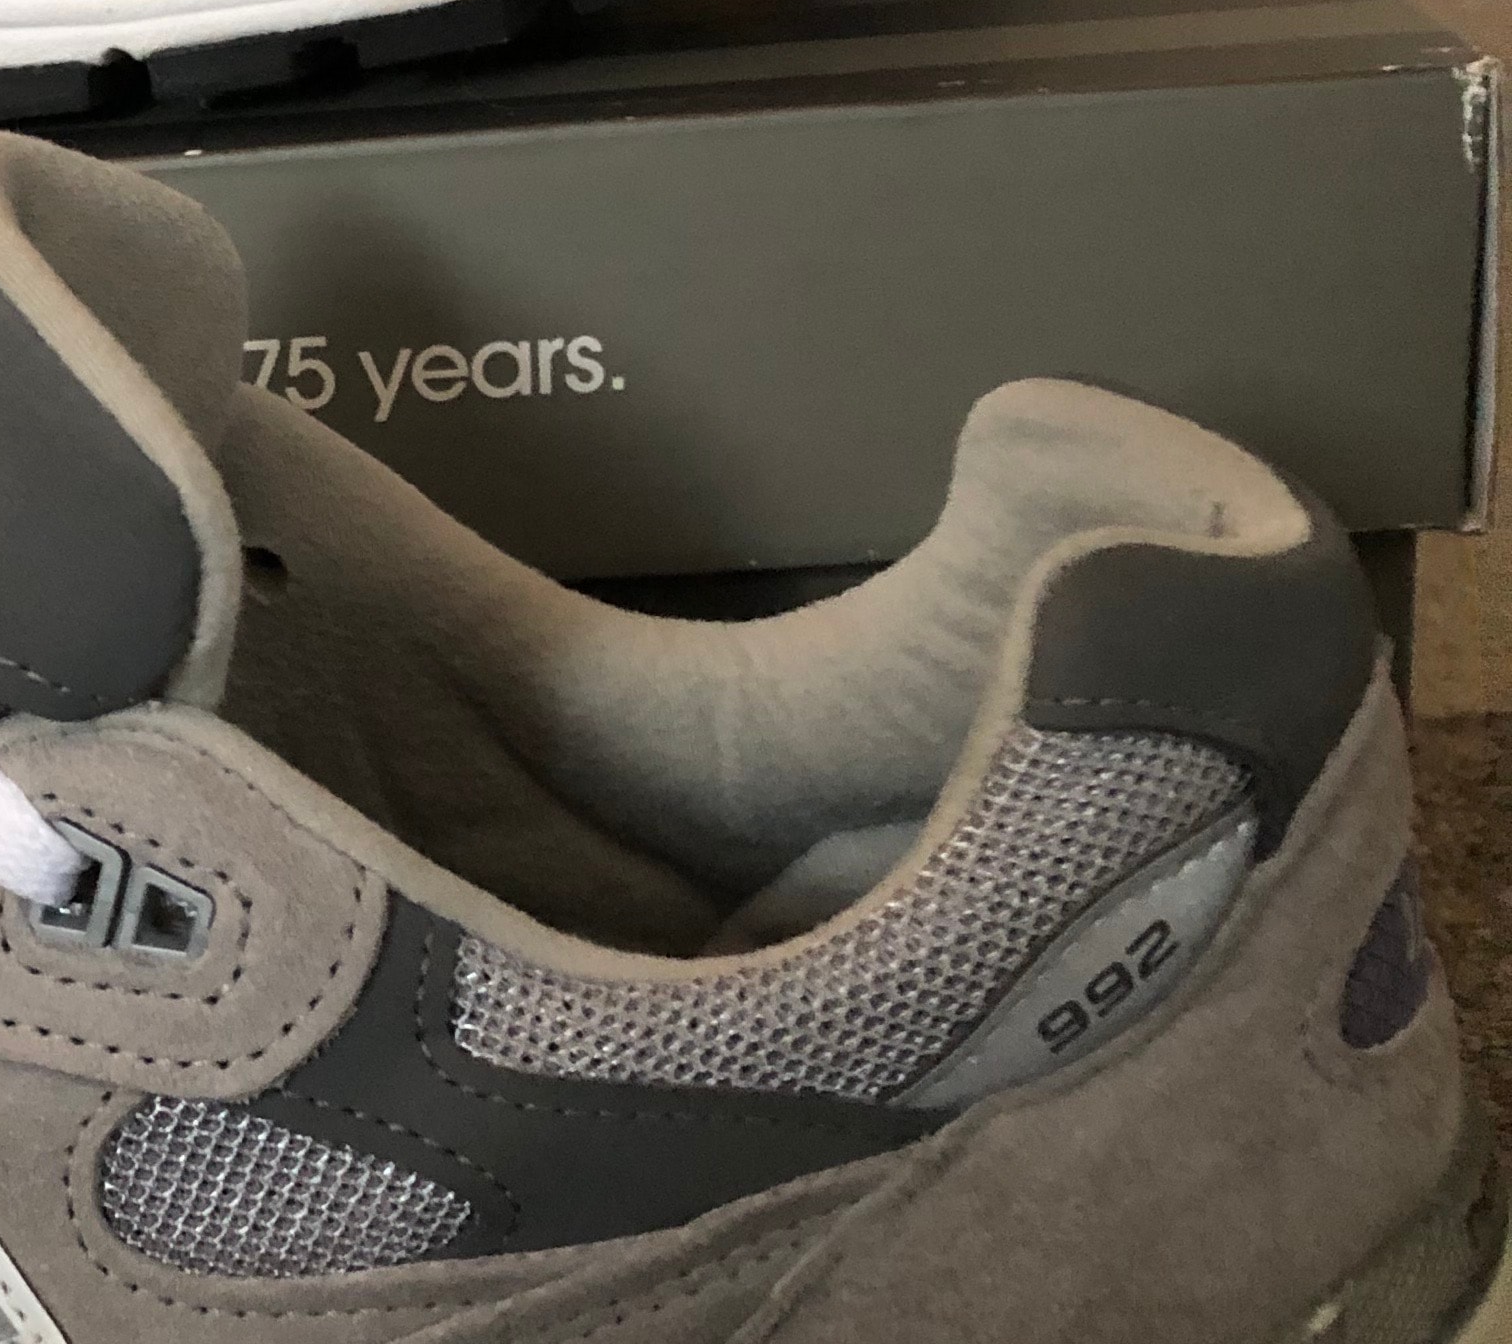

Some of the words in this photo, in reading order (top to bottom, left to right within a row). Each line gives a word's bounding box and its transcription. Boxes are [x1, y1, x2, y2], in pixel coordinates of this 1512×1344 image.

[243, 336, 336, 410] 75
[358, 335, 625, 423] years.
[1037, 919, 1180, 1055] 992
